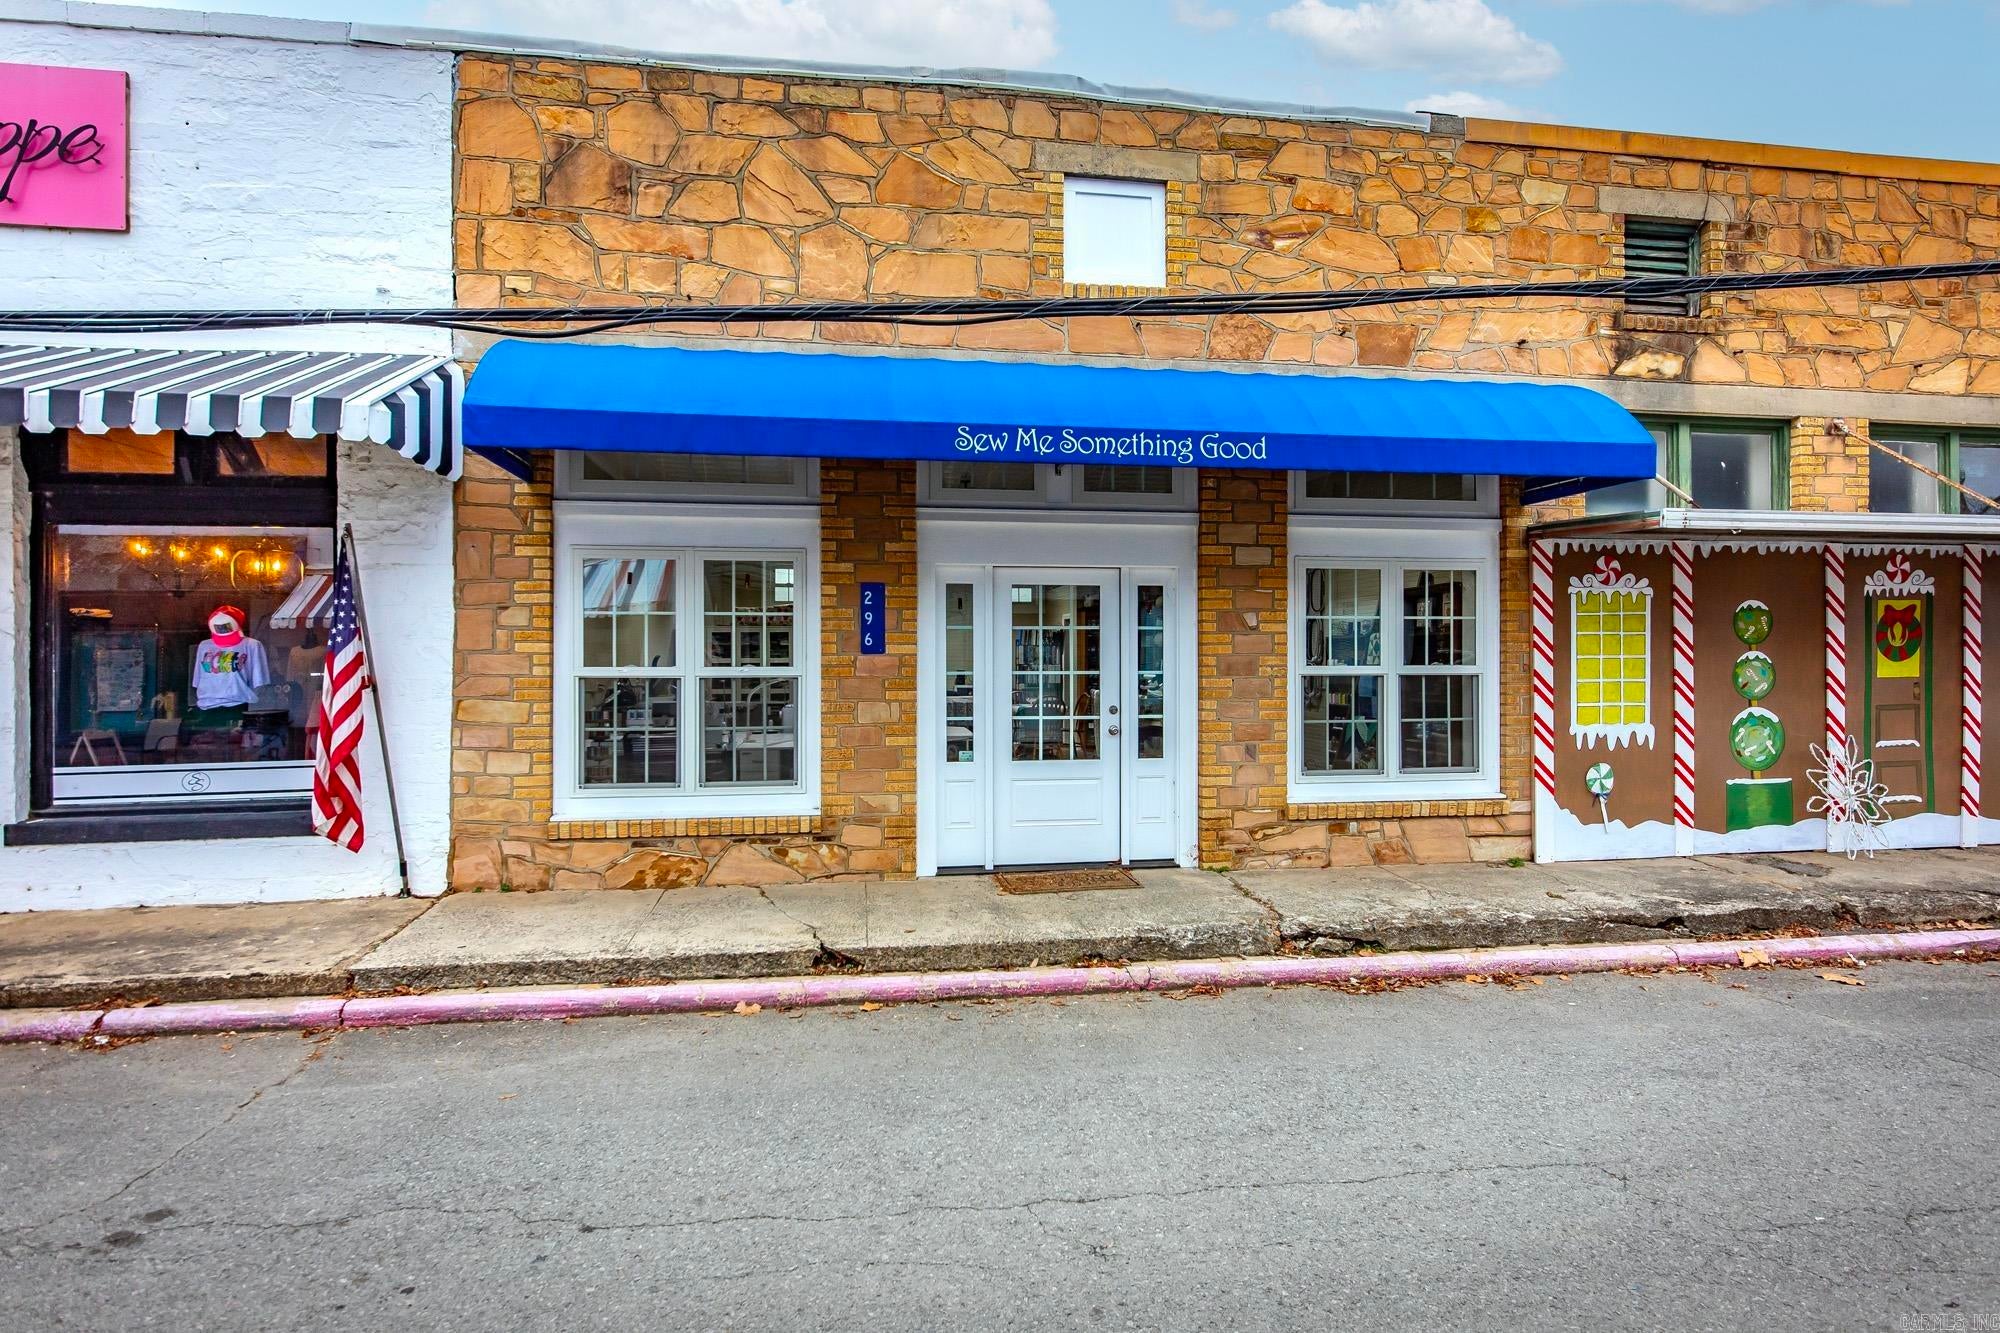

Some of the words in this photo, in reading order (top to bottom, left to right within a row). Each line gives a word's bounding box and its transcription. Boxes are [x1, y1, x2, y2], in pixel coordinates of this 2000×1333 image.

[955, 426, 1008, 454] Sew
[1015, 427, 1055, 456] Me
[1059, 428, 1194, 464] Something
[1199, 433, 1267, 460] Good
[864, 591, 873, 646] 296
